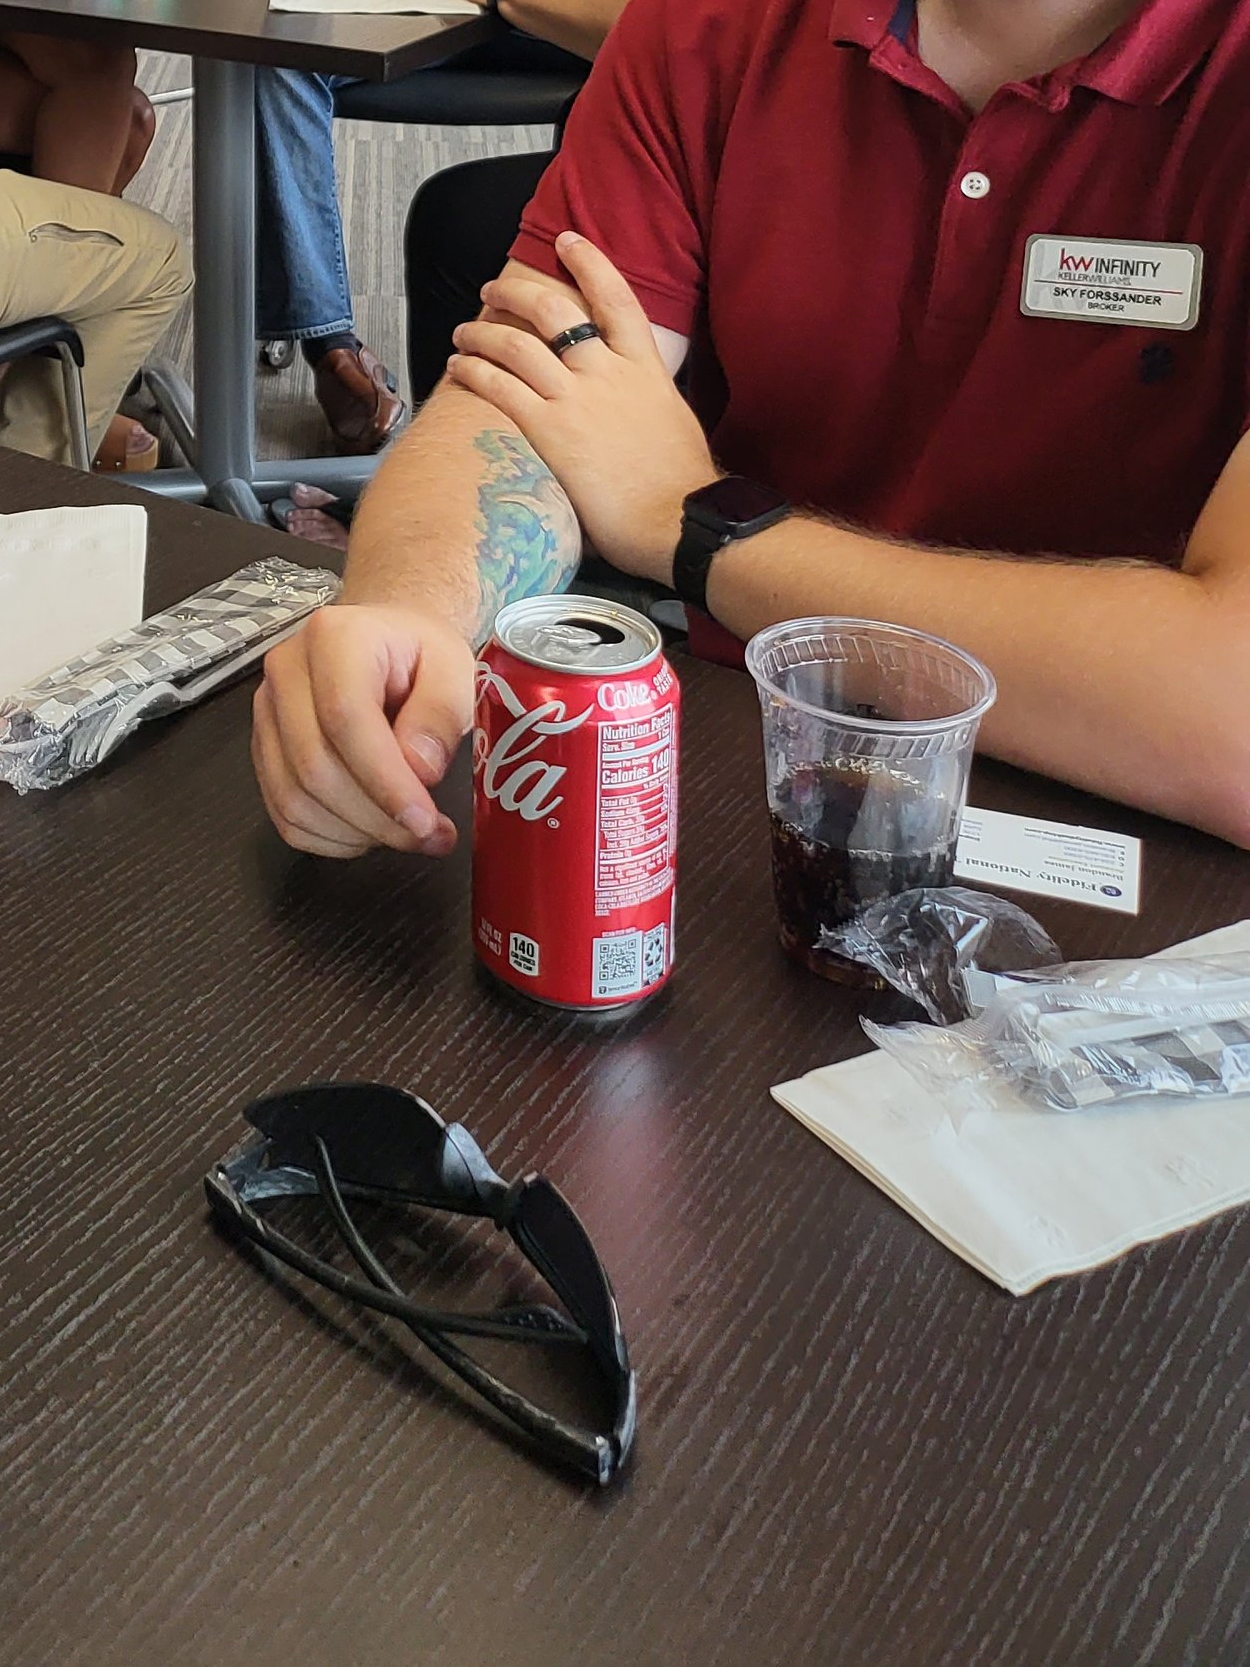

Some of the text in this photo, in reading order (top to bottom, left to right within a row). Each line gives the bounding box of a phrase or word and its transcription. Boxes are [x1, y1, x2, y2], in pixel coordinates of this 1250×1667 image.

[1095, 257, 1162, 278] INFINITY
[1053, 286, 1162, 306] SKY FORSSANDER
[1087, 301, 1125, 312] BROKER
[597, 680, 650, 712] Coke
[602, 711, 671, 740] Nutrition Facts
[602, 766, 649, 784] Calories
[651, 748, 669, 774] 140
[965, 857, 1097, 892] Fidelity National
[513, 936, 535, 958] 140
